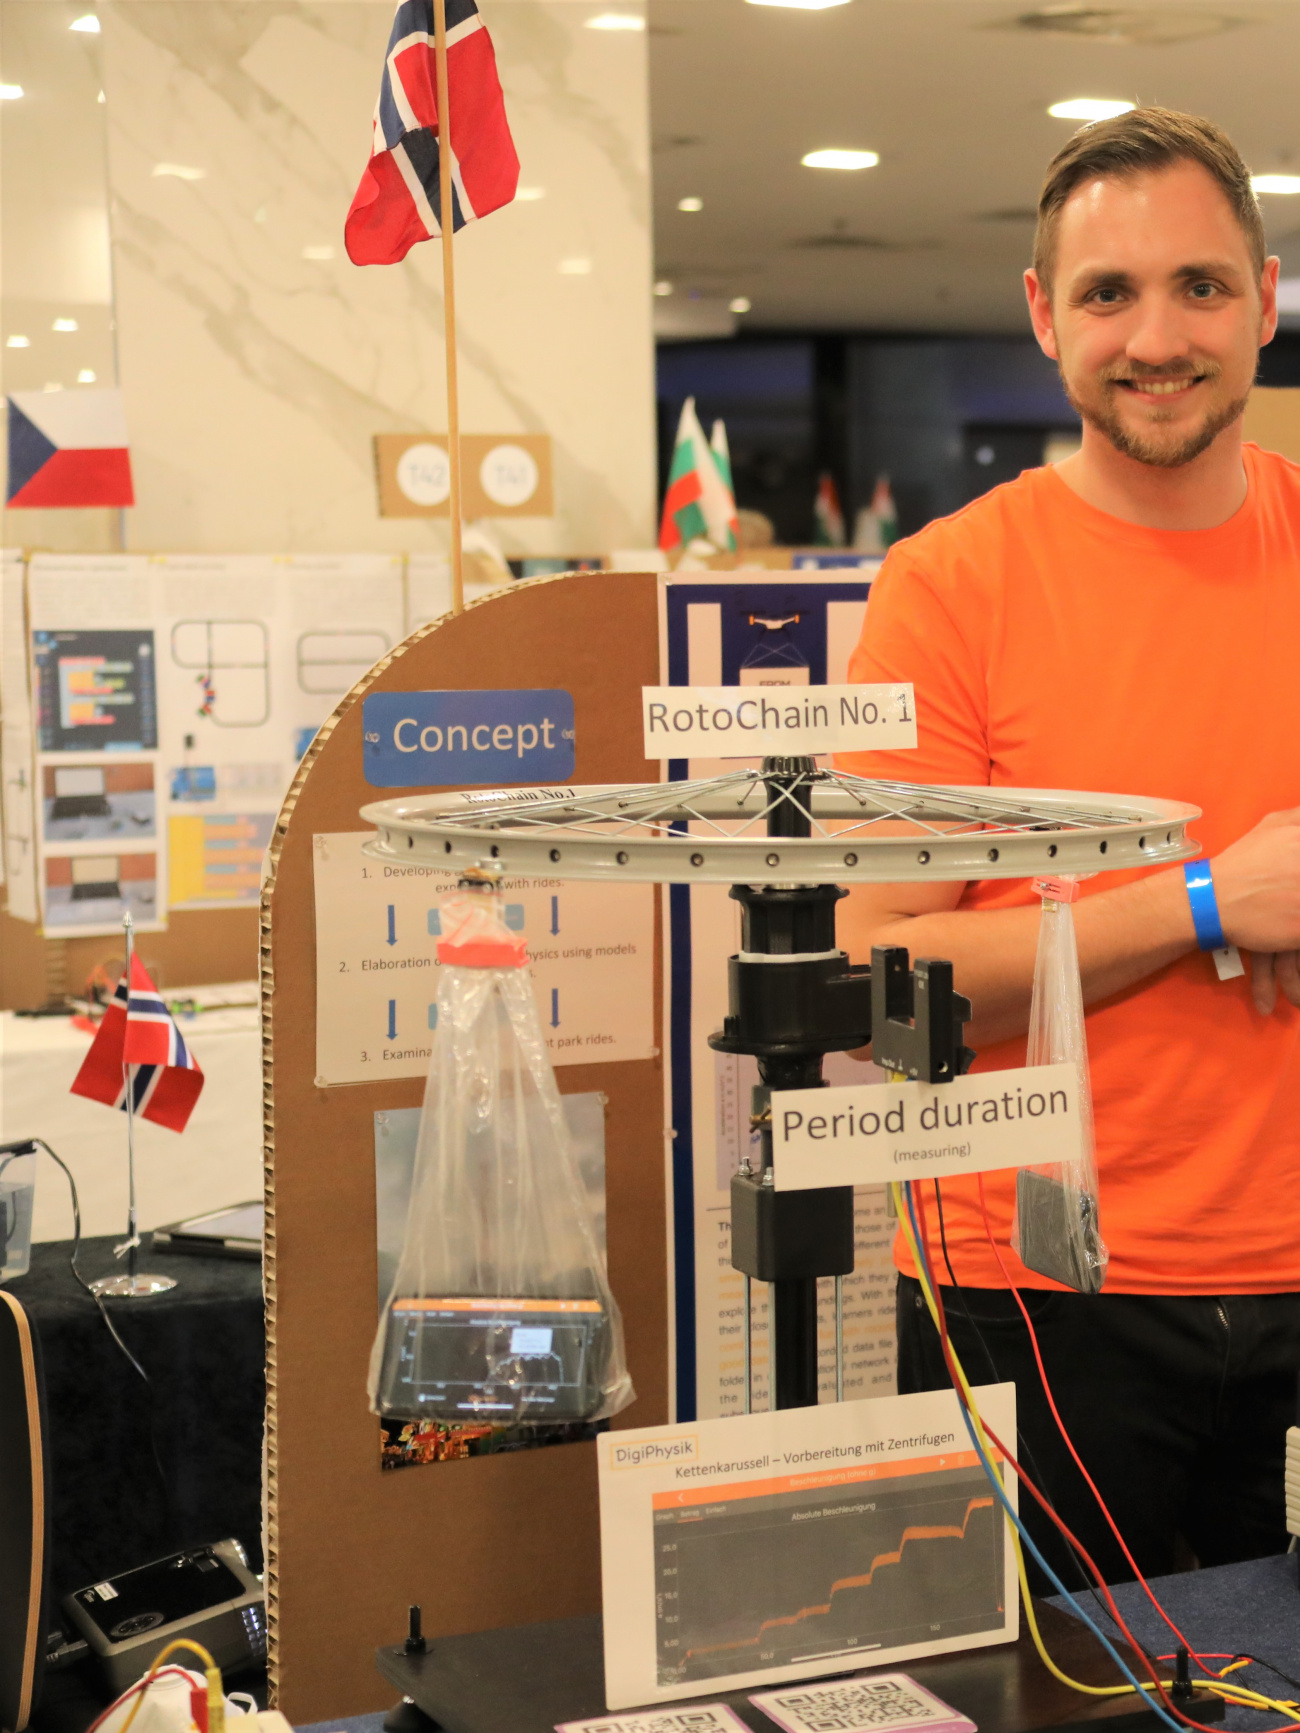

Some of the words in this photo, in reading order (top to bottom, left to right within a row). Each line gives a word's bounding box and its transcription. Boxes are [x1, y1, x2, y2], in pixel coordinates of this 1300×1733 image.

[648, 698, 829, 733] RotoChain
[840, 696, 887, 727] No.
[896, 693, 912, 723] 1
[393, 716, 556, 759] Concept
[361, 867, 373, 879] 1.
[504, 878, 530, 890] with
[533, 878, 565, 889] rides.
[525, 949, 559, 963] hysics
[562, 946, 593, 960] using
[595, 943, 637, 956] models
[339, 961, 350, 973] 2.
[361, 957, 431, 972] Elaboration
[557, 1035, 583, 1049] park
[586, 1033, 617, 1045] rides.
[360, 1051, 372, 1063] 3.
[382, 1047, 433, 1061] Examina
[783, 1100, 906, 1142] Period
[920, 1087, 1069, 1131] duration
[893, 1142, 972, 1165] (measuring)
[616, 1441, 693, 1464] DigiPhysik
[675, 1456, 770, 1479] Kettenkarussell
[783, 1444, 862, 1465] Vorbereitung
[865, 1440, 885, 1453] mit
[887, 1432, 955, 1450] Zentrifugen
[791, 1508, 822, 1522] Absolute
[822, 1502, 876, 1518] Beschleunigung
